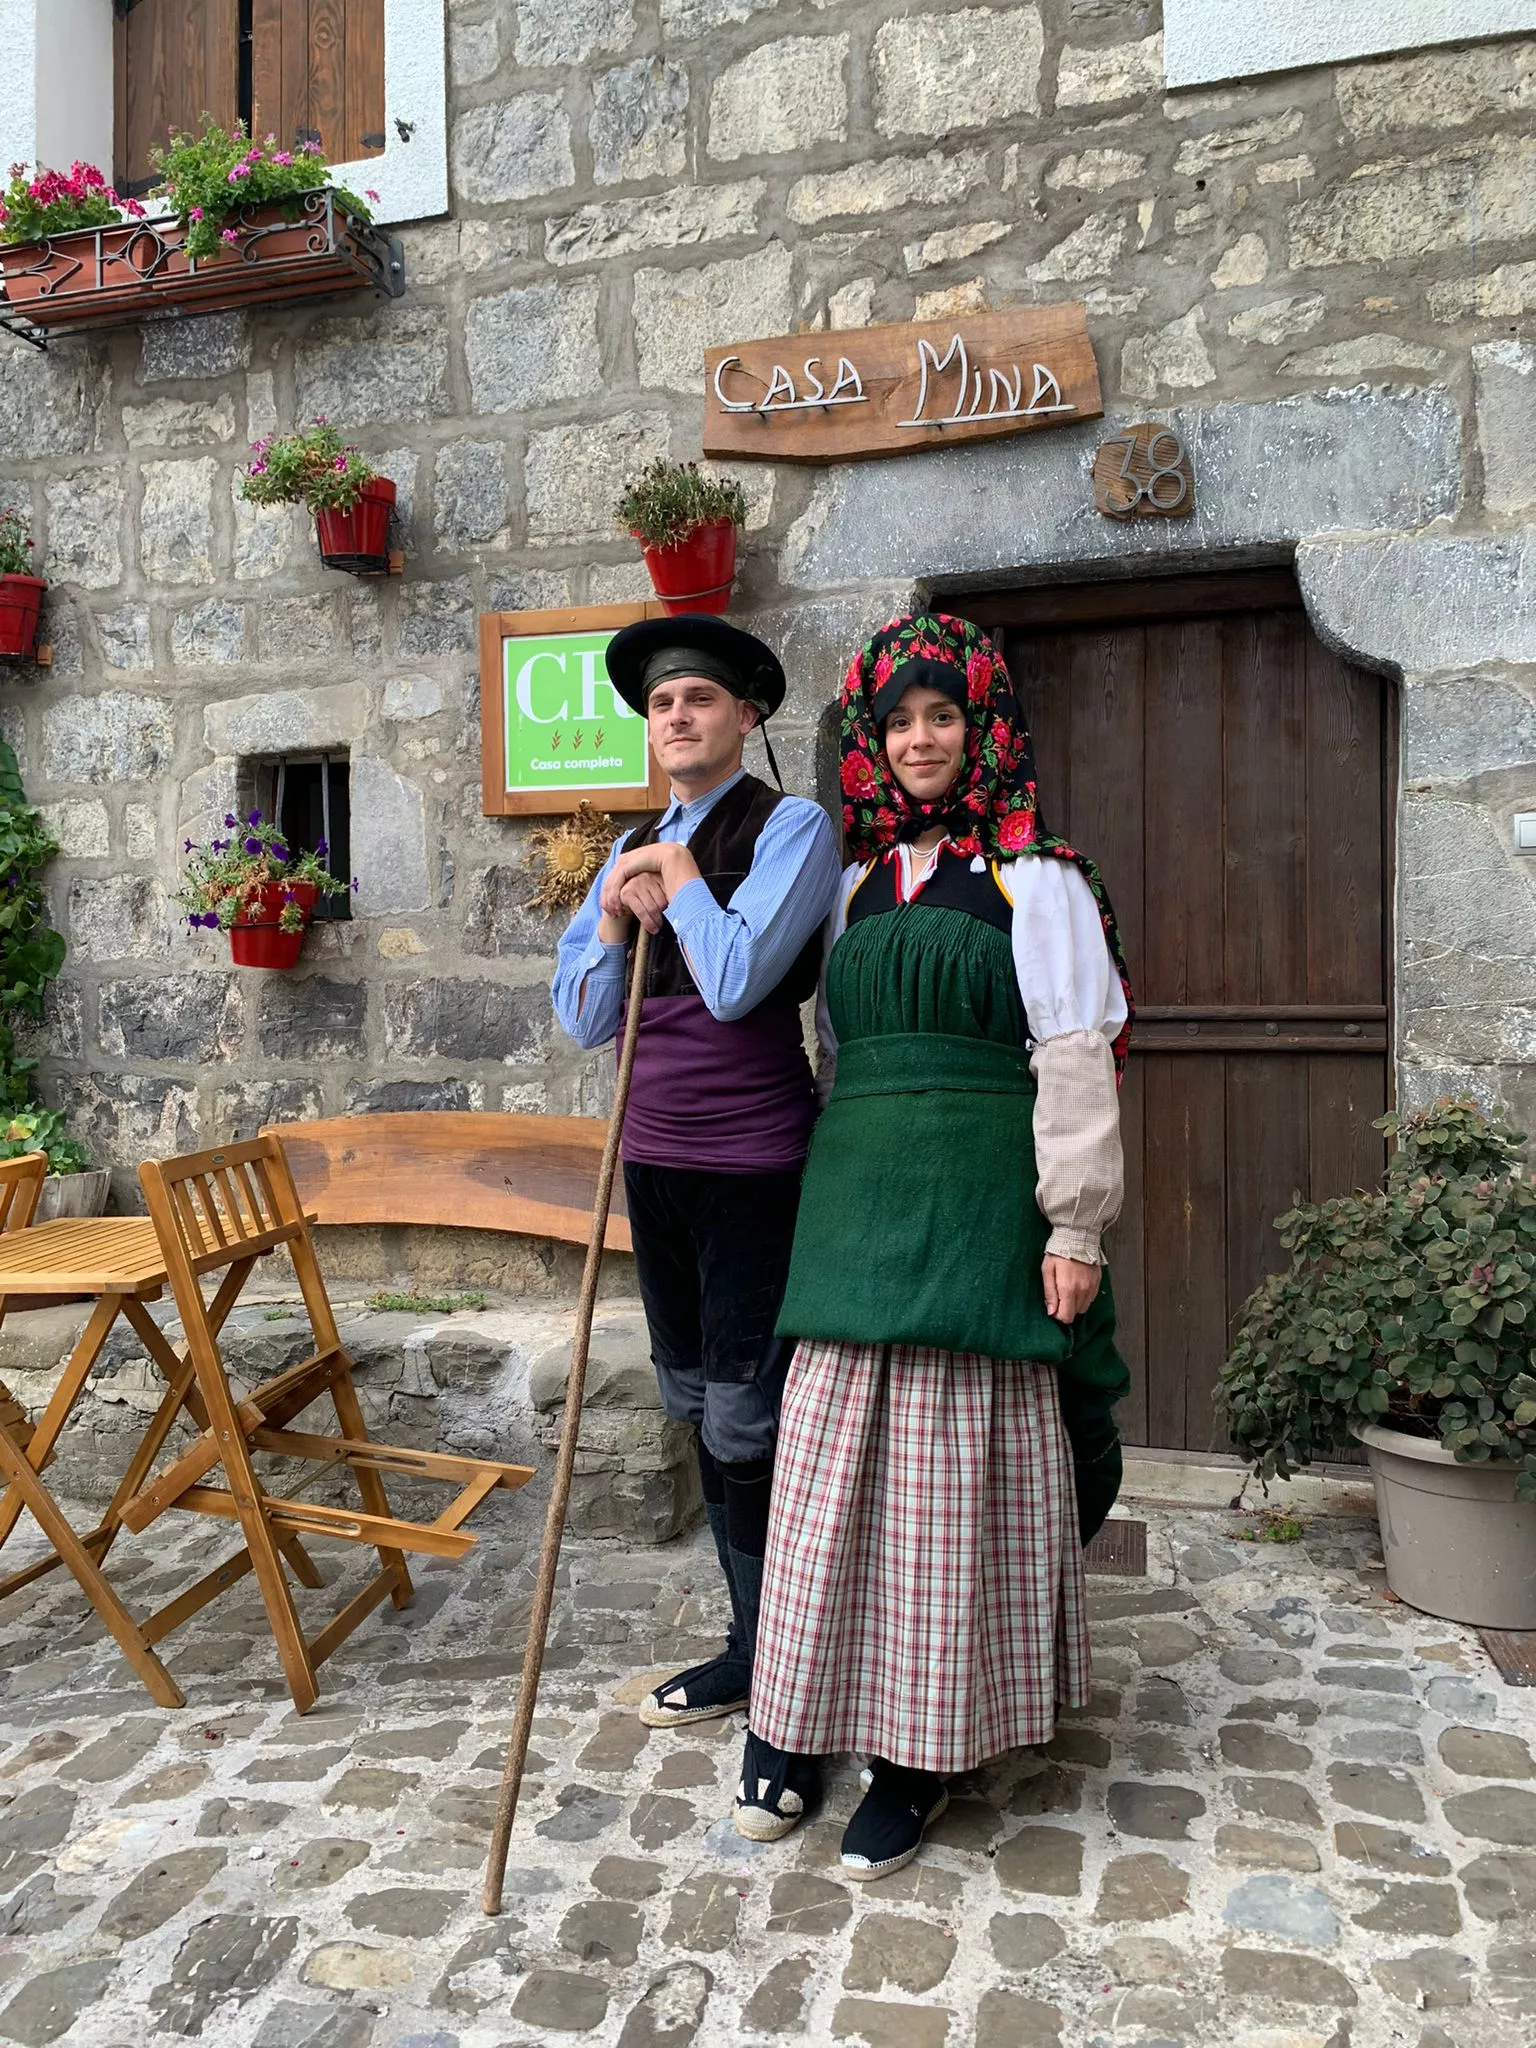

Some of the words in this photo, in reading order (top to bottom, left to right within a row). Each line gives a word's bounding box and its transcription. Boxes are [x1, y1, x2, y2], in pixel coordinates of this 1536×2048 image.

[714, 355, 862, 407] CASA
[1103, 431, 1187, 512] 38
[530, 758, 561, 770] Casa
[564, 756, 623, 771] completa
